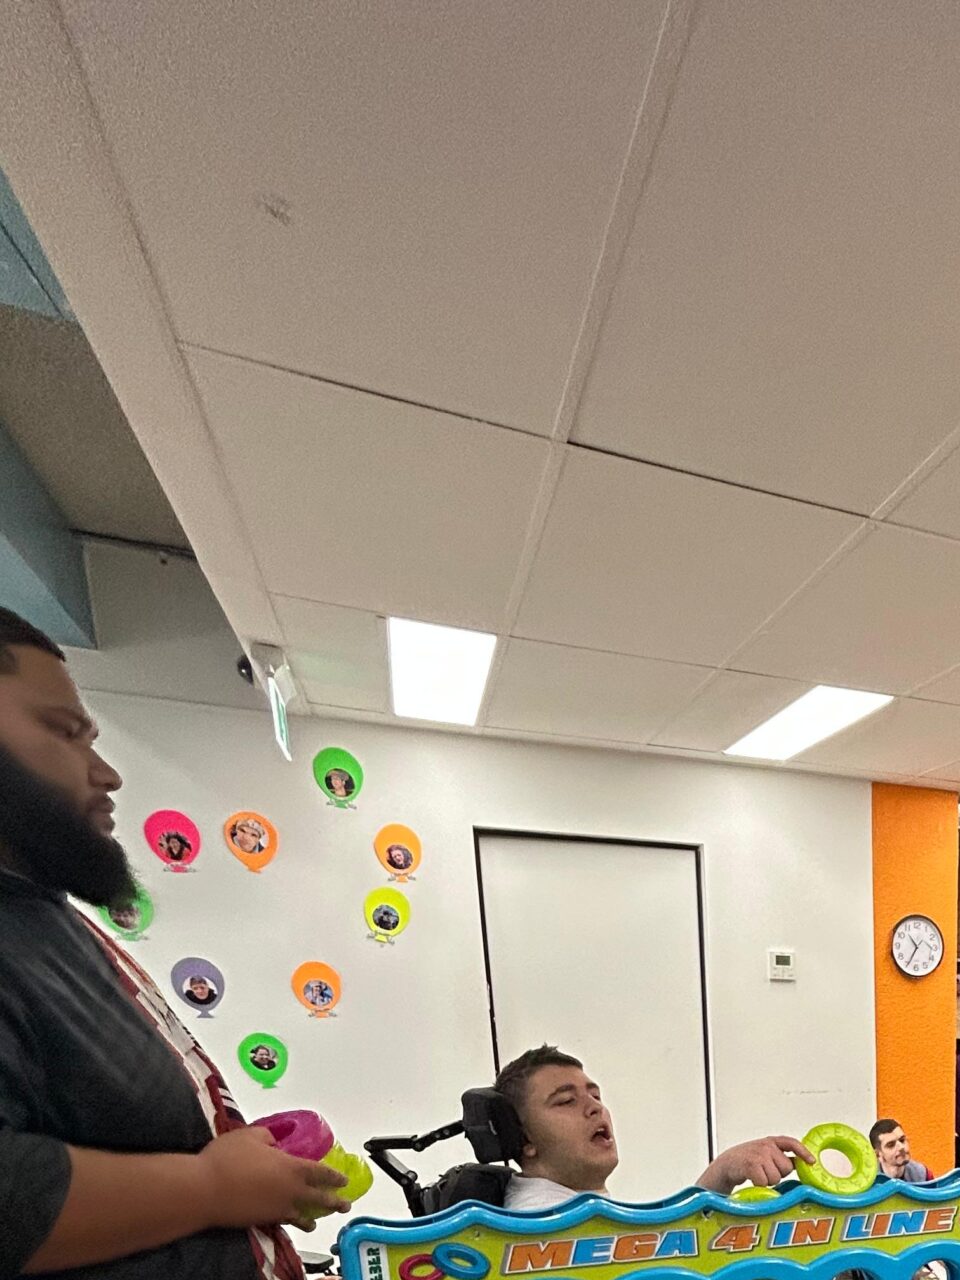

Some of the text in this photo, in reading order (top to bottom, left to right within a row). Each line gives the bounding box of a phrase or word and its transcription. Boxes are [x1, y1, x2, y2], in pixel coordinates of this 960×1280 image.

[505, 1206, 958, 1275] MEGA 4 IN LINE
